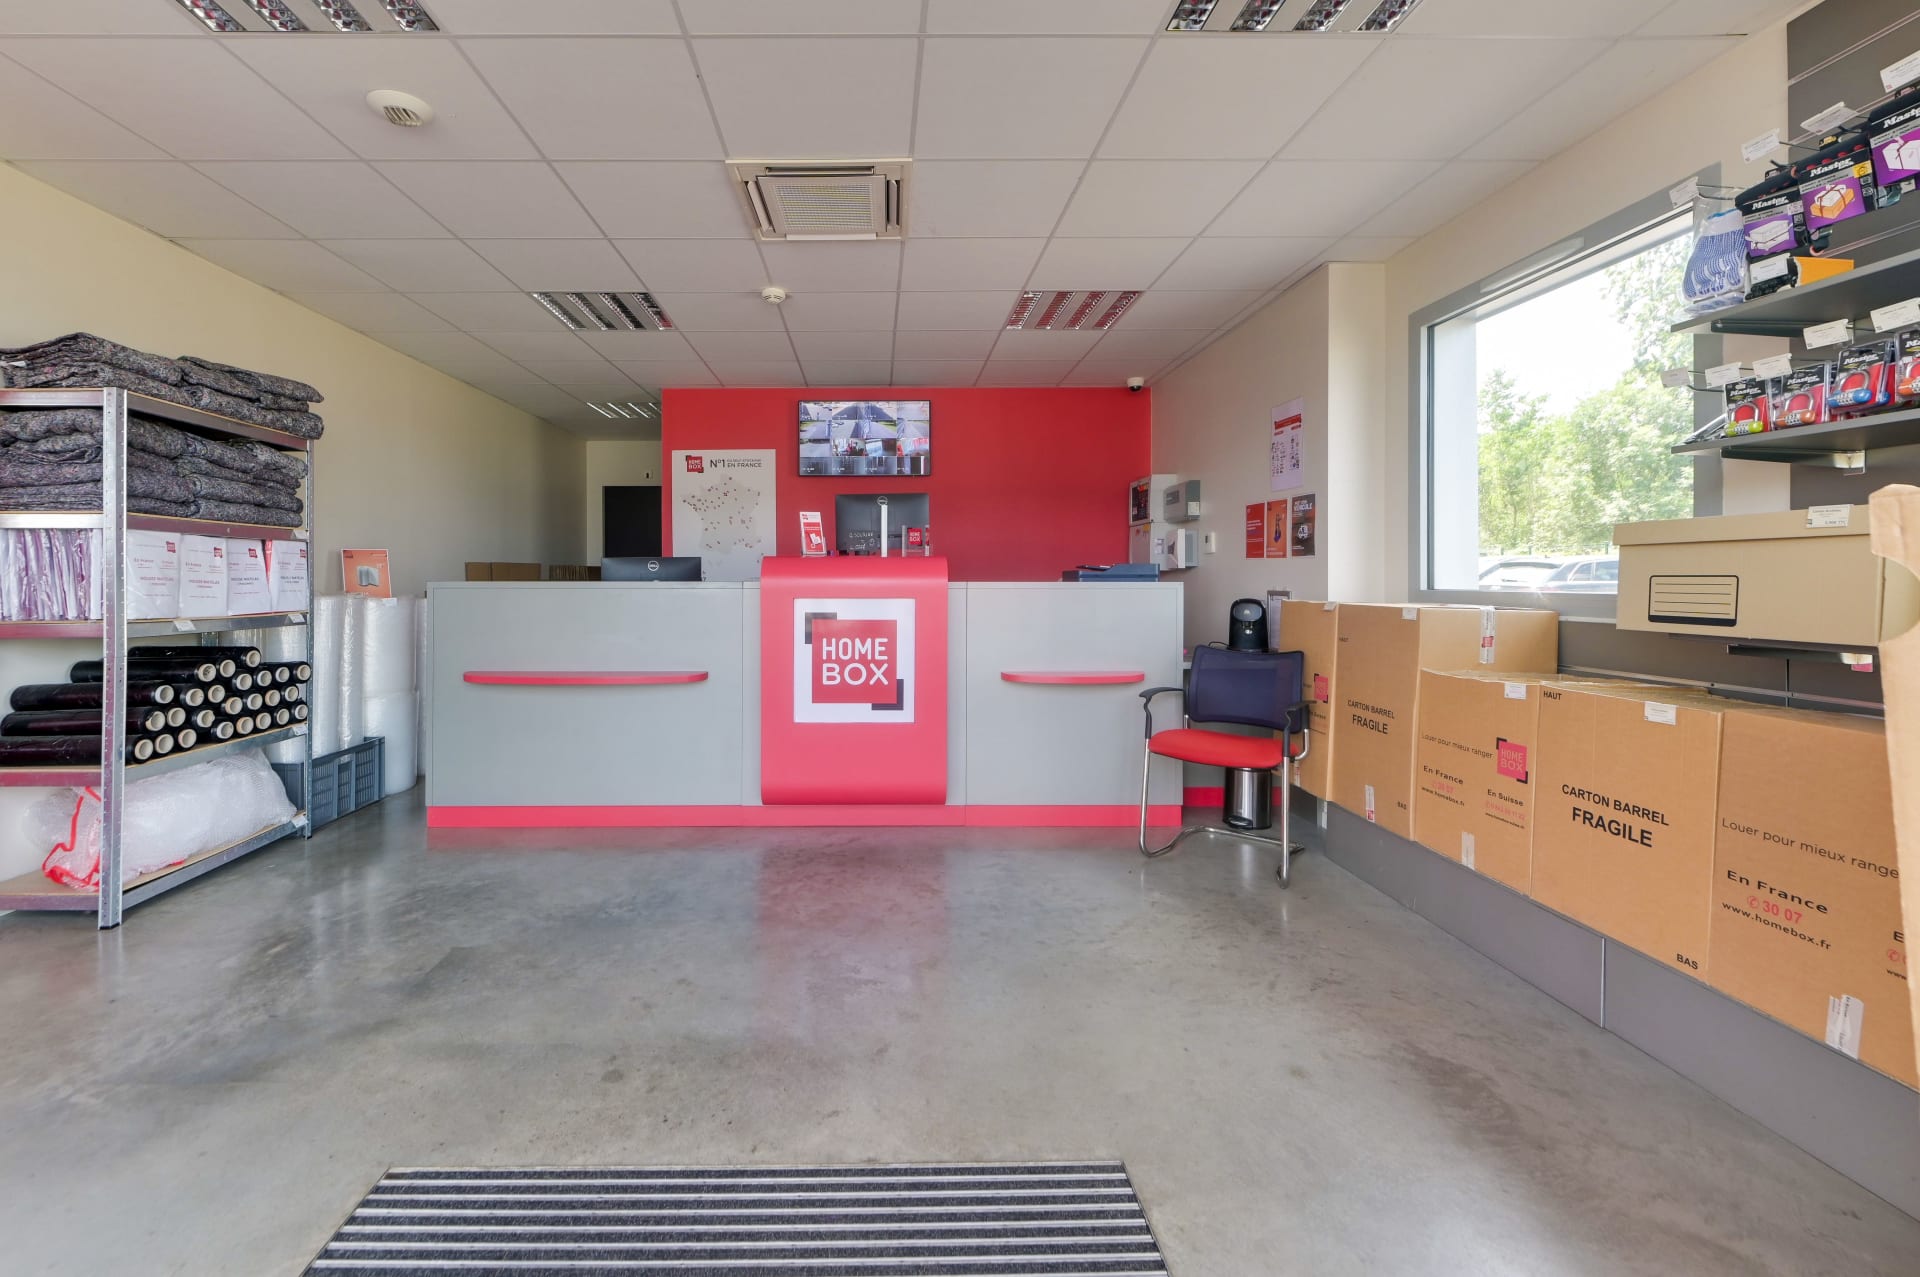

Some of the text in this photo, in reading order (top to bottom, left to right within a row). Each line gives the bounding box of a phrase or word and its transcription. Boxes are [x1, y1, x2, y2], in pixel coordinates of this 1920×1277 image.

[822, 637, 889, 661] HOME
[822, 662, 889, 686] BOX
[1543, 690, 1563, 701] HAUT
[1347, 699, 1395, 720] CARTON BARREL
[1352, 714, 1389, 735] FRAGILE
[1472, 748, 1494, 759] ranger
[1501, 748, 1523, 763] HOME
[1423, 765, 1464, 785] En France
[1501, 759, 1523, 773] BOX
[1487, 788, 1524, 807] En Suisse
[1561, 784, 1670, 826] CARTON BARREL
[1572, 806, 1653, 848] FRAGILE
[1722, 817, 1900, 879] Louer pour mieux range
[1727, 869, 1829, 914] En France
[1762, 900, 1803, 925] 30 07
[1722, 901, 1832, 950] www.homebox.fr
[1893, 930, 1905, 944] E
[1676, 953, 1698, 970] BAS
